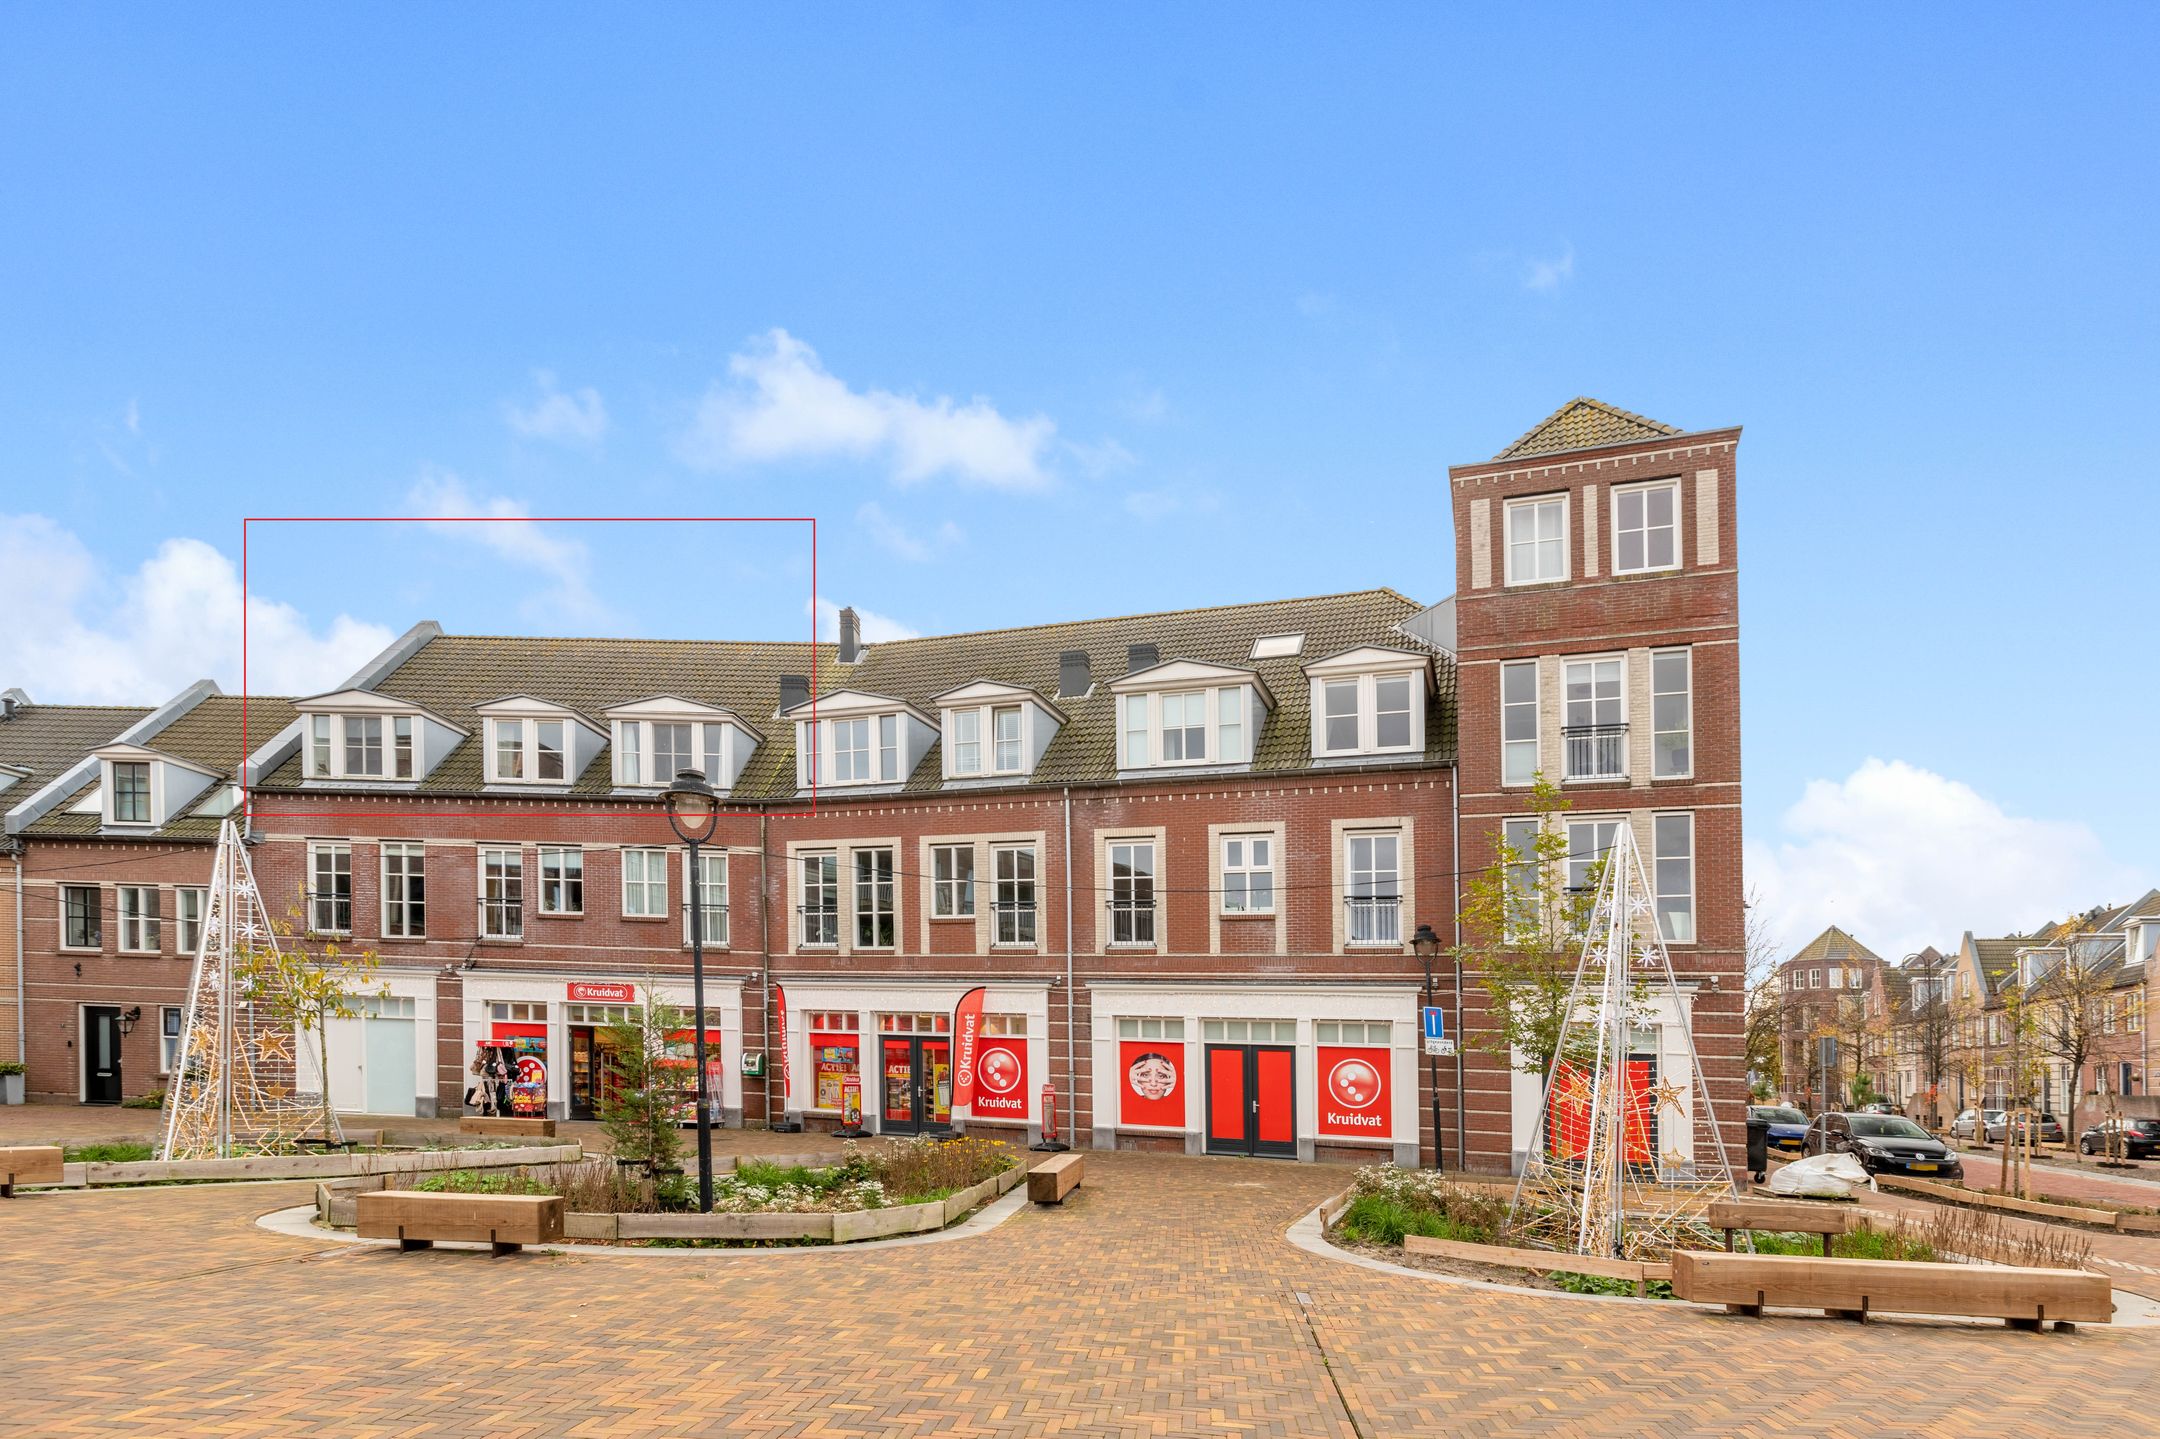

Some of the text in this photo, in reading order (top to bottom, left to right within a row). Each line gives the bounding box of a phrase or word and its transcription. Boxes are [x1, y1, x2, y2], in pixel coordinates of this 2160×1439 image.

[587, 987, 624, 998] Kruidvat
[960, 1013, 975, 1069] Kruidvat
[978, 1096, 1022, 1109] Kruidvat
[1327, 1112, 1382, 1126] Kruidvat
